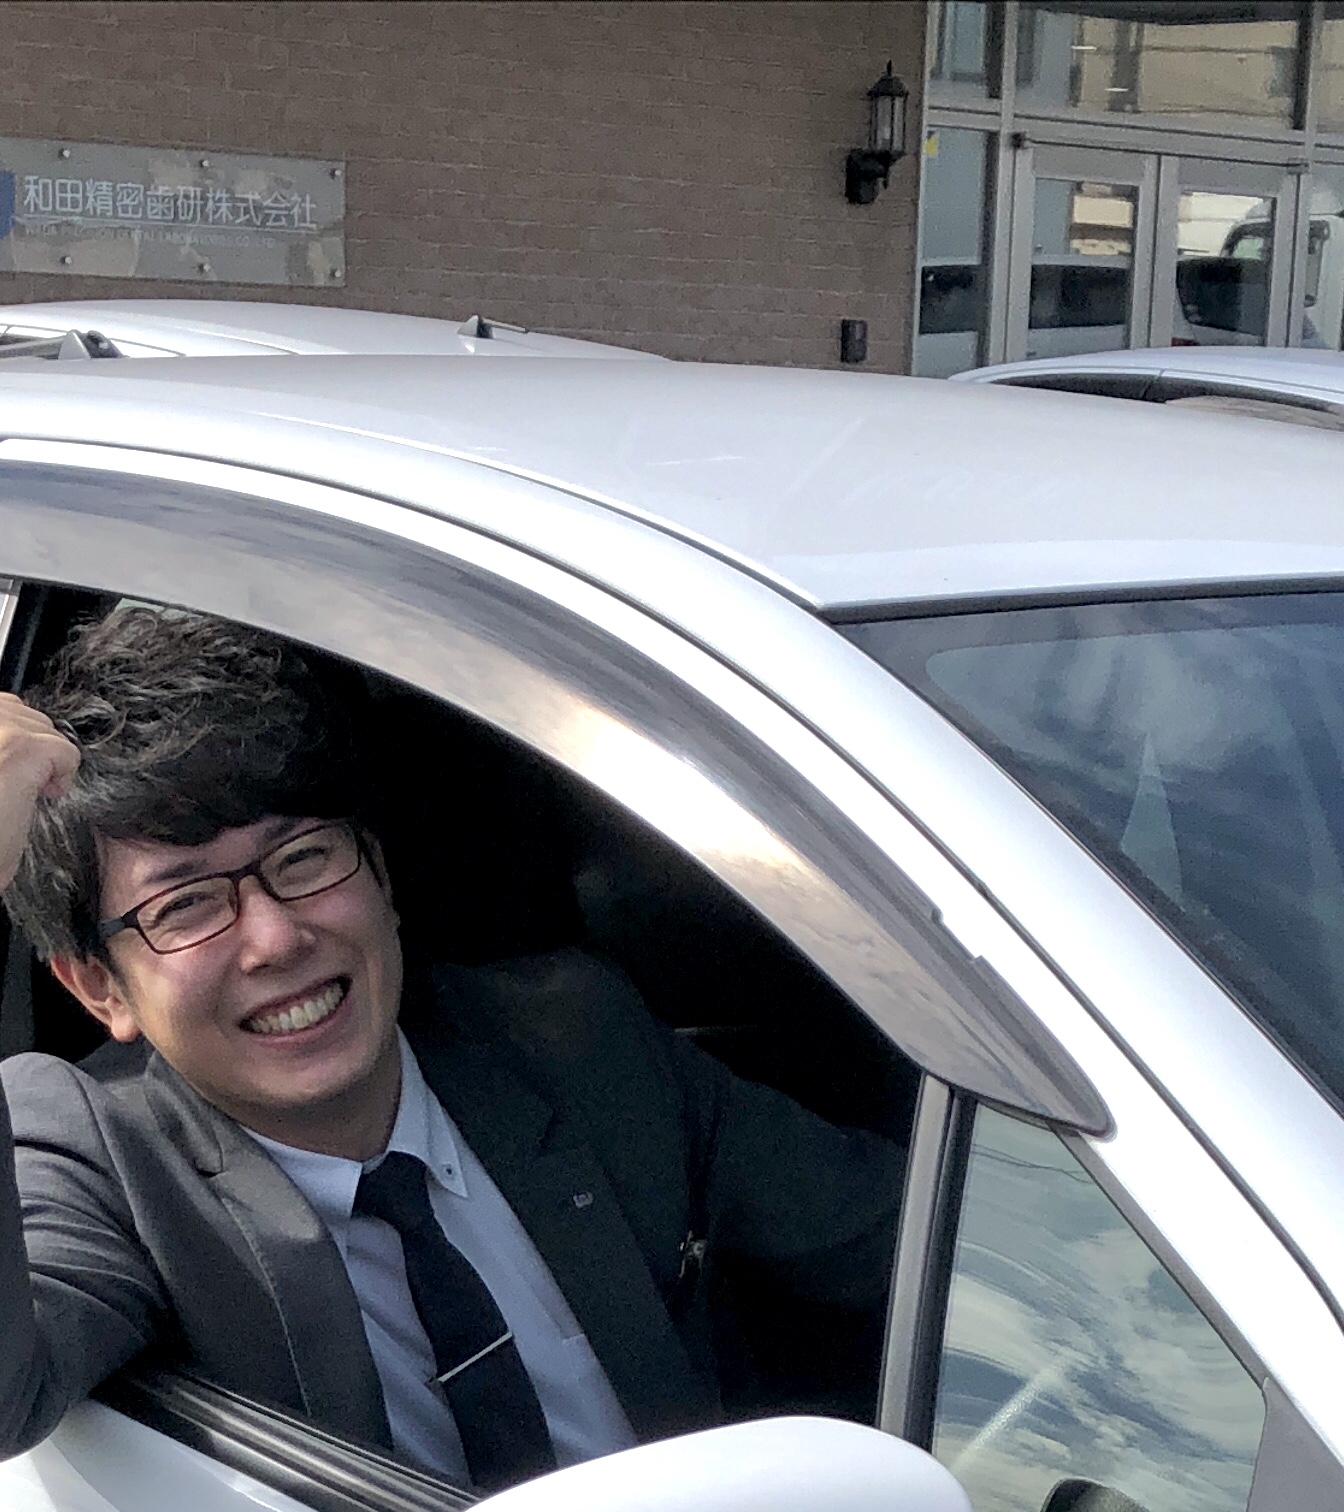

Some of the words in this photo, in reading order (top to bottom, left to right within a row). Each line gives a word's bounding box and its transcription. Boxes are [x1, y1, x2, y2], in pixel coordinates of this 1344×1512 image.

[24, 175, 317, 230] 和田精密歯研株式会社
